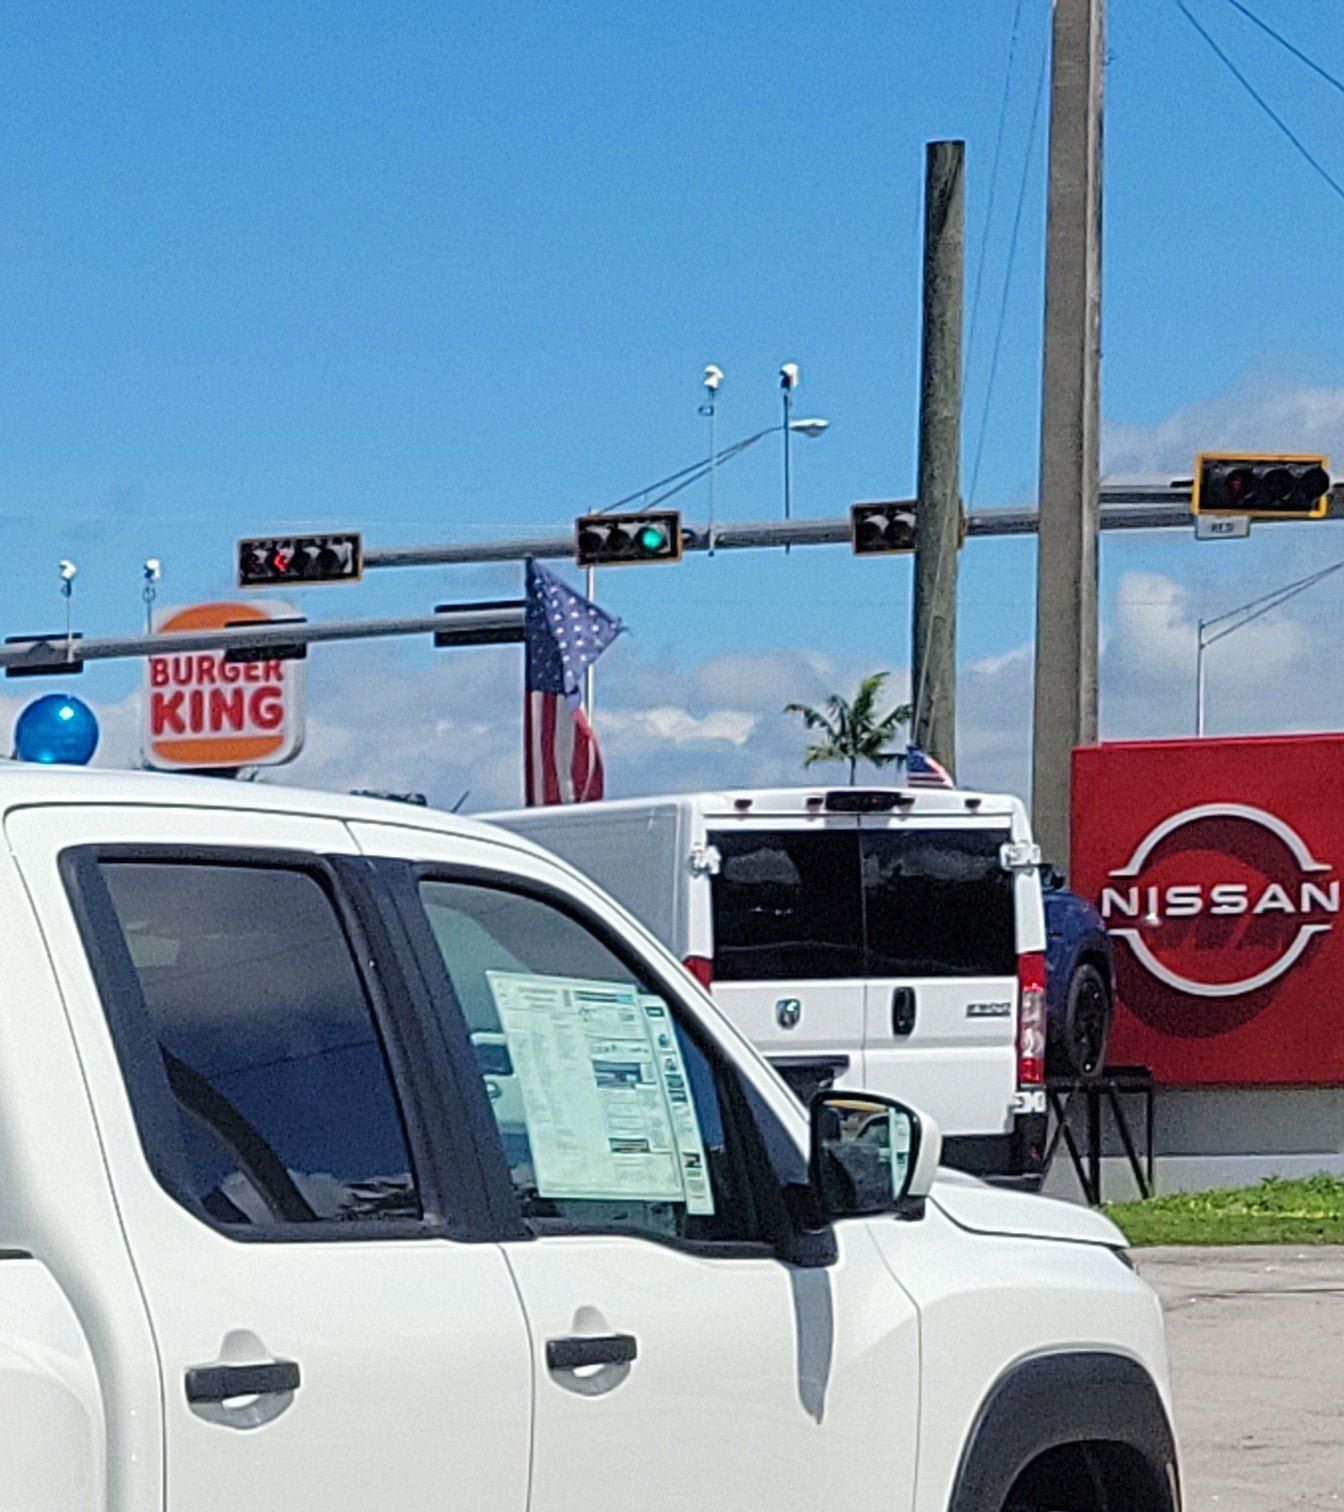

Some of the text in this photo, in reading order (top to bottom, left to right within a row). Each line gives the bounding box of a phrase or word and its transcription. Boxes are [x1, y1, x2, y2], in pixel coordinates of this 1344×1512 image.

[151, 655, 283, 687] BURGER
[151, 686, 284, 735] KING
[1101, 880, 1340, 918] NISSAN
